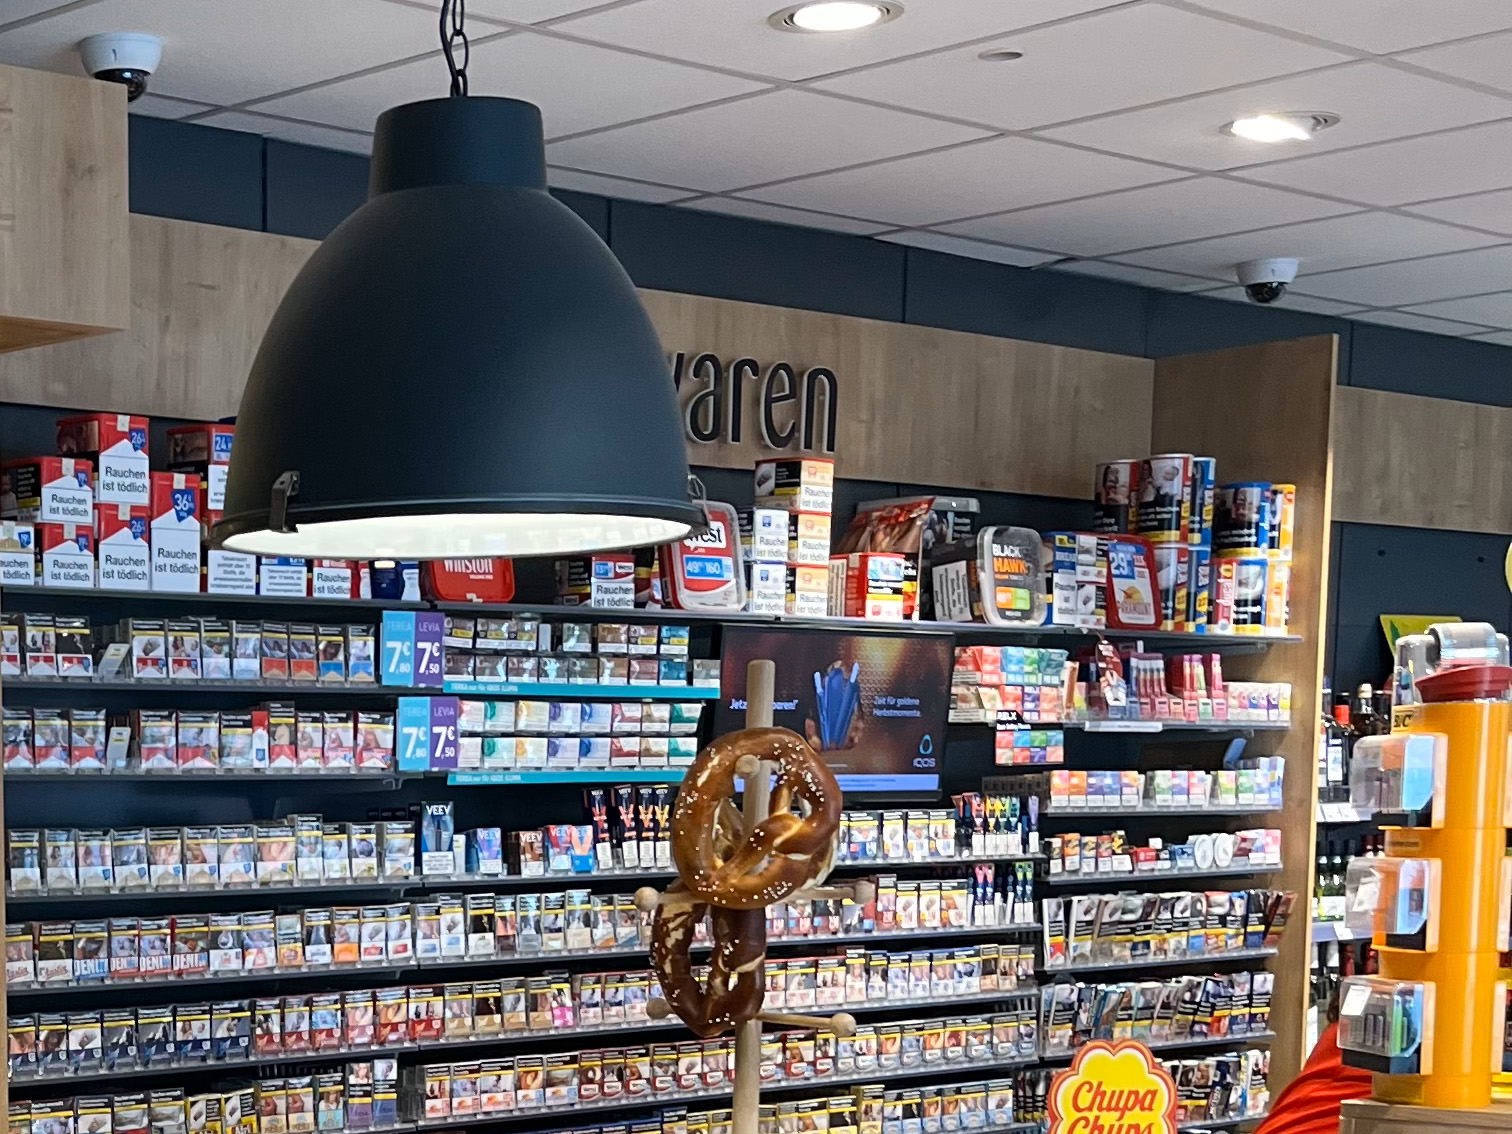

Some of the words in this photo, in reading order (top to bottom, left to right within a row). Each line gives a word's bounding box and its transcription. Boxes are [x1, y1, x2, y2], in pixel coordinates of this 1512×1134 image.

[673, 351, 838, 452] aren
[105, 466, 146, 480] Rauchen
[102, 481, 115, 492] ist
[117, 481, 148, 494] tödlich
[51, 494, 87, 505] Rauchen
[49, 506, 60, 515] ist
[62, 506, 89, 516] tödlich
[157, 547, 198, 560] Rauchen
[992, 543, 1022, 558] BLACK
[0, 559, 29, 569] auchen
[52, 560, 88, 571] Rauchen
[105, 555, 146, 567] Rauchen
[993, 558, 1029, 575] HAWK
[3, 569, 31, 580] tödlich
[155, 562, 168, 573] ist
[170, 562, 199, 575] tödlich
[51, 571, 61, 581] ist
[63, 571, 90, 582] tödlich
[102, 569, 115, 579] ist
[117, 569, 148, 581] tödlich
[418, 622, 440, 633] LEVIA
[433, 706, 455, 717] LEVIA
[426, 804, 451, 816] VEEV
[520, 832, 543, 843] VEEV
[1071, 1080, 1158, 1123] Chupa
